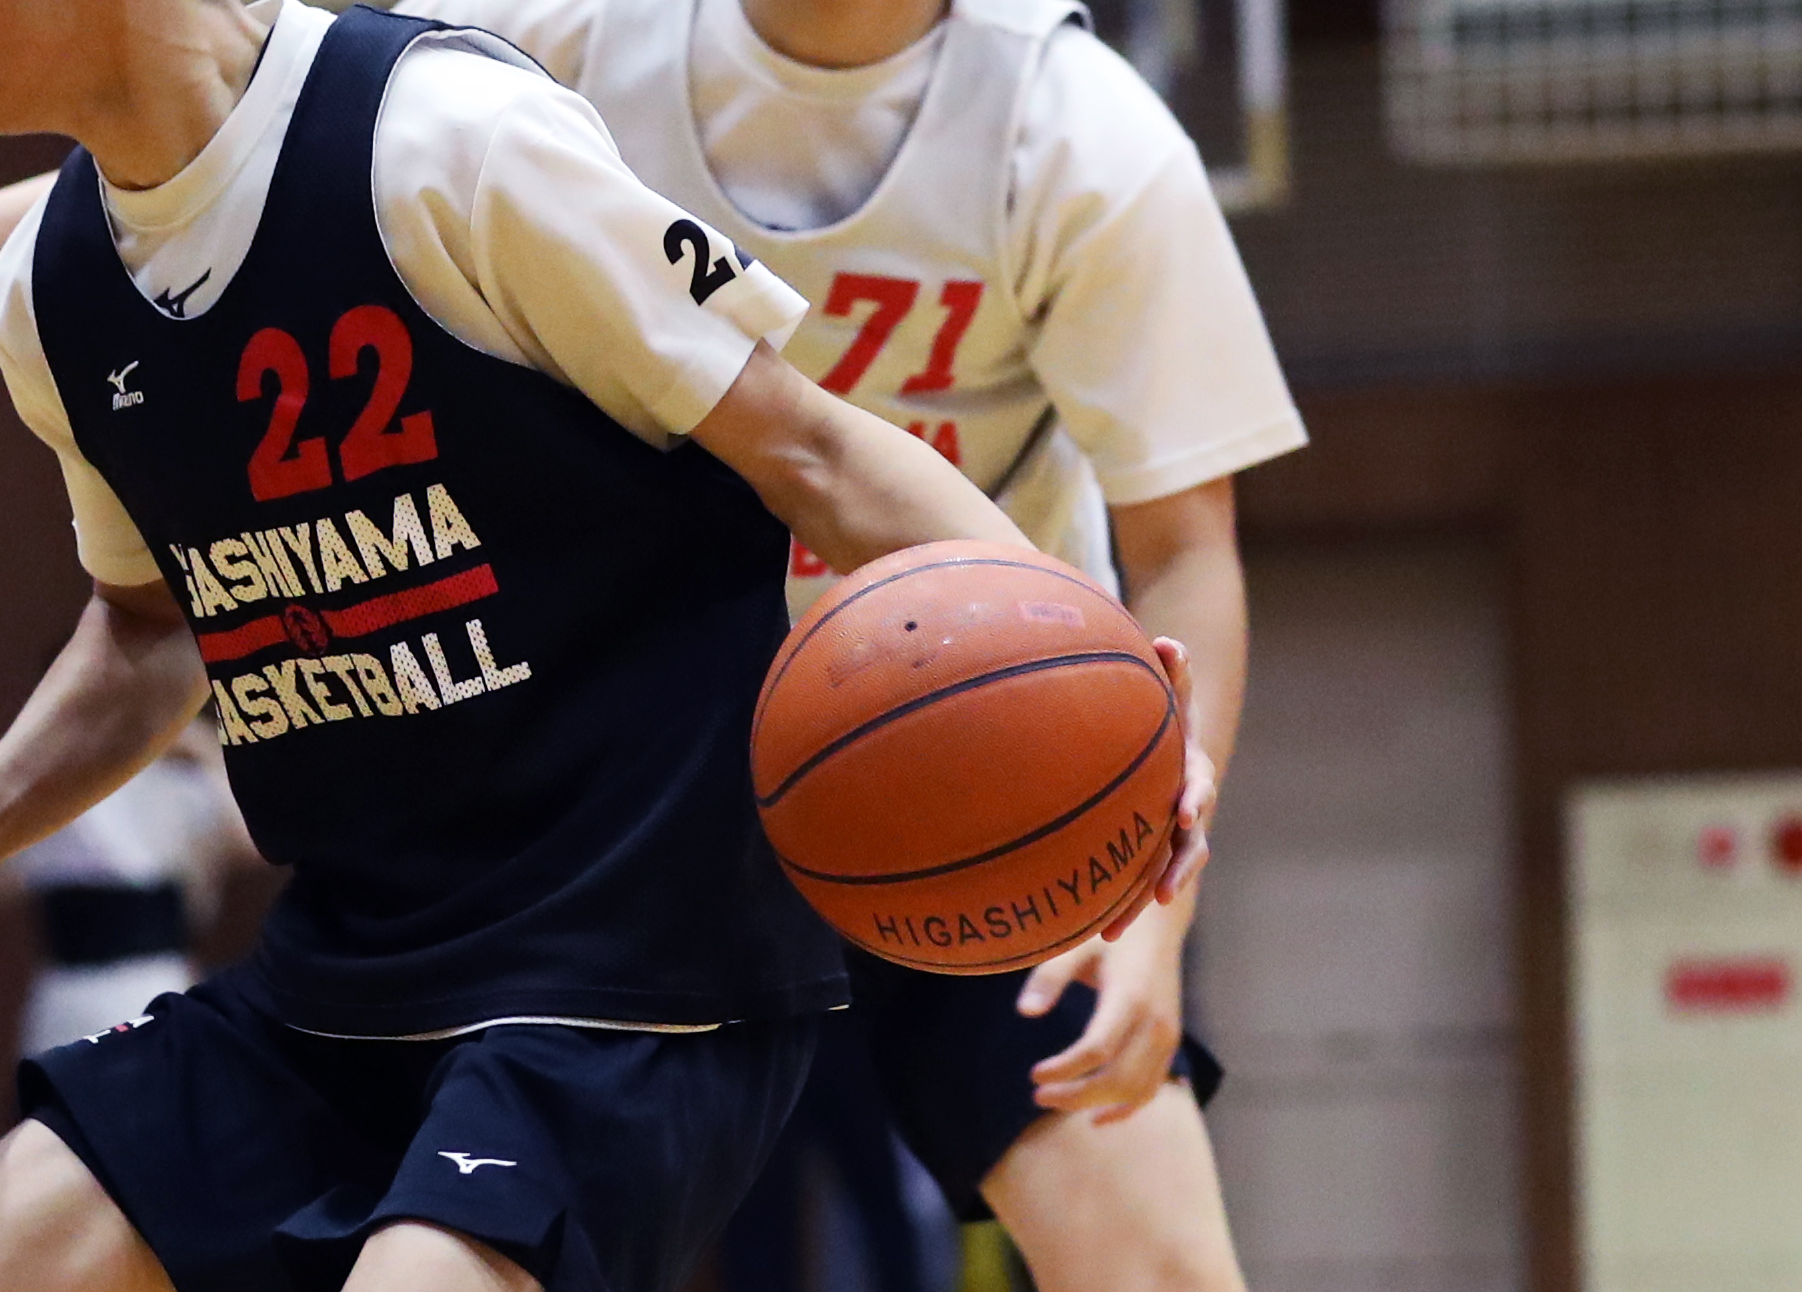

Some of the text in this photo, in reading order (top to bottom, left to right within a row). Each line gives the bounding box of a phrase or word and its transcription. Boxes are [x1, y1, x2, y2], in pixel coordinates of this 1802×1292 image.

[822, 273, 985, 394] 71
[236, 305, 438, 501] 22
[211, 619, 532, 746] ASKETBALL
[872, 811, 1155, 948] HIGASHIYAMA
